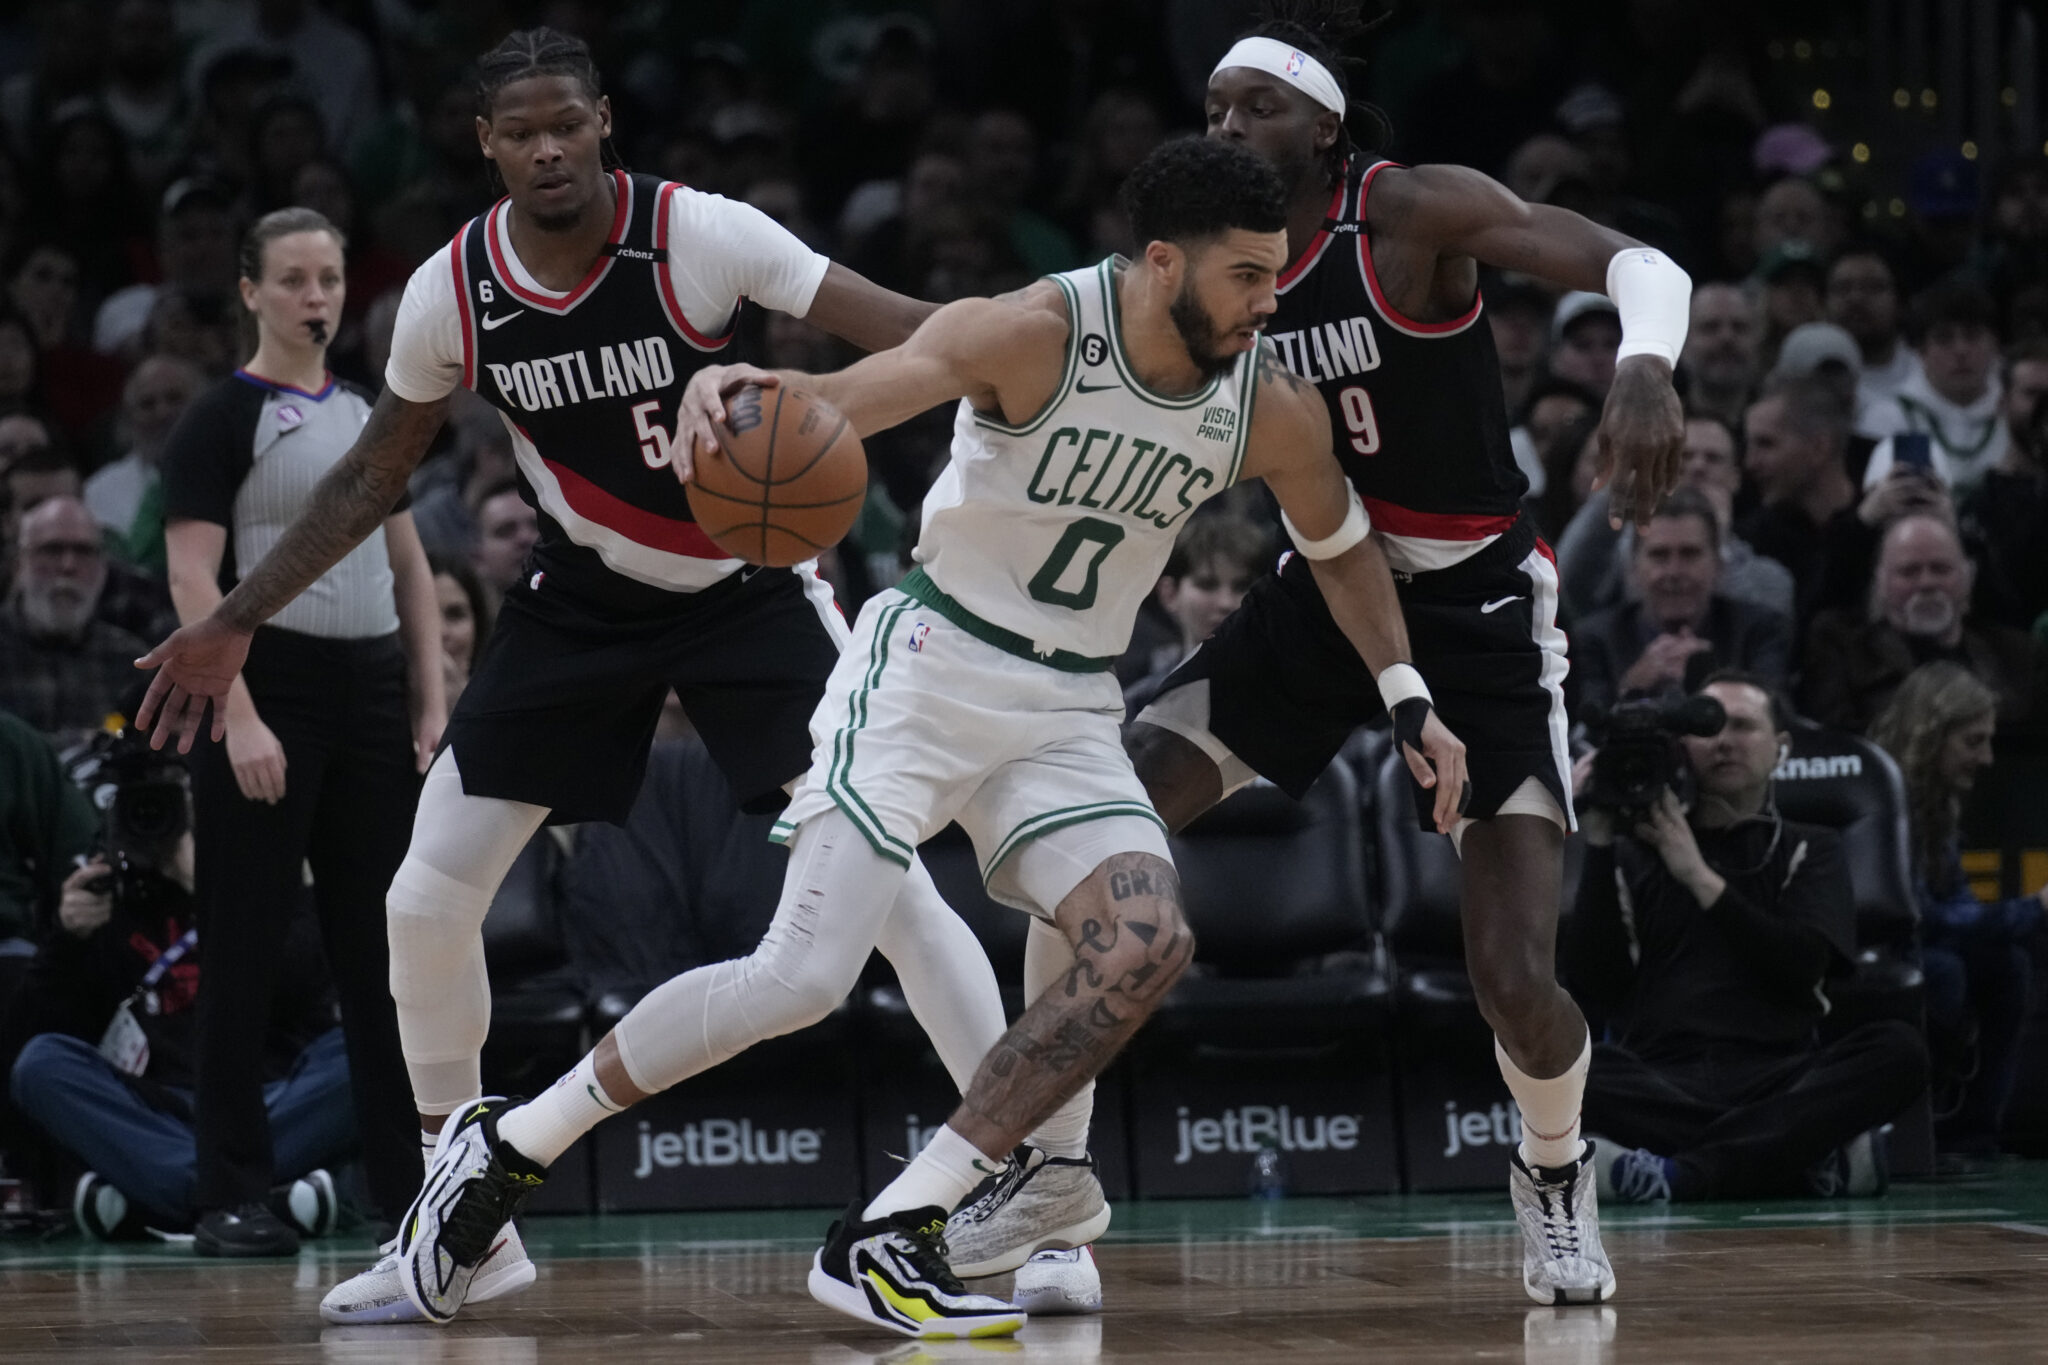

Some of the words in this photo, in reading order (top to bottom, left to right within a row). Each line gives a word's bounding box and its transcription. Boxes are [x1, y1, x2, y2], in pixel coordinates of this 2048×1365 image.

[478, 279, 495, 303] 6
[485, 335, 676, 412] PORTLAND
[1085, 336, 1103, 364] 6
[630, 399, 674, 471] 5
[1196, 424, 1234, 444] PRINT
[1202, 406, 1237, 429] VISTA
[1339, 385, 1381, 456] 9
[1027, 426, 1214, 529] CELTICS
[1027, 515, 1126, 611] 0
[634, 1117, 822, 1178] jetBlue
[1174, 1104, 1361, 1165] jetBlue
